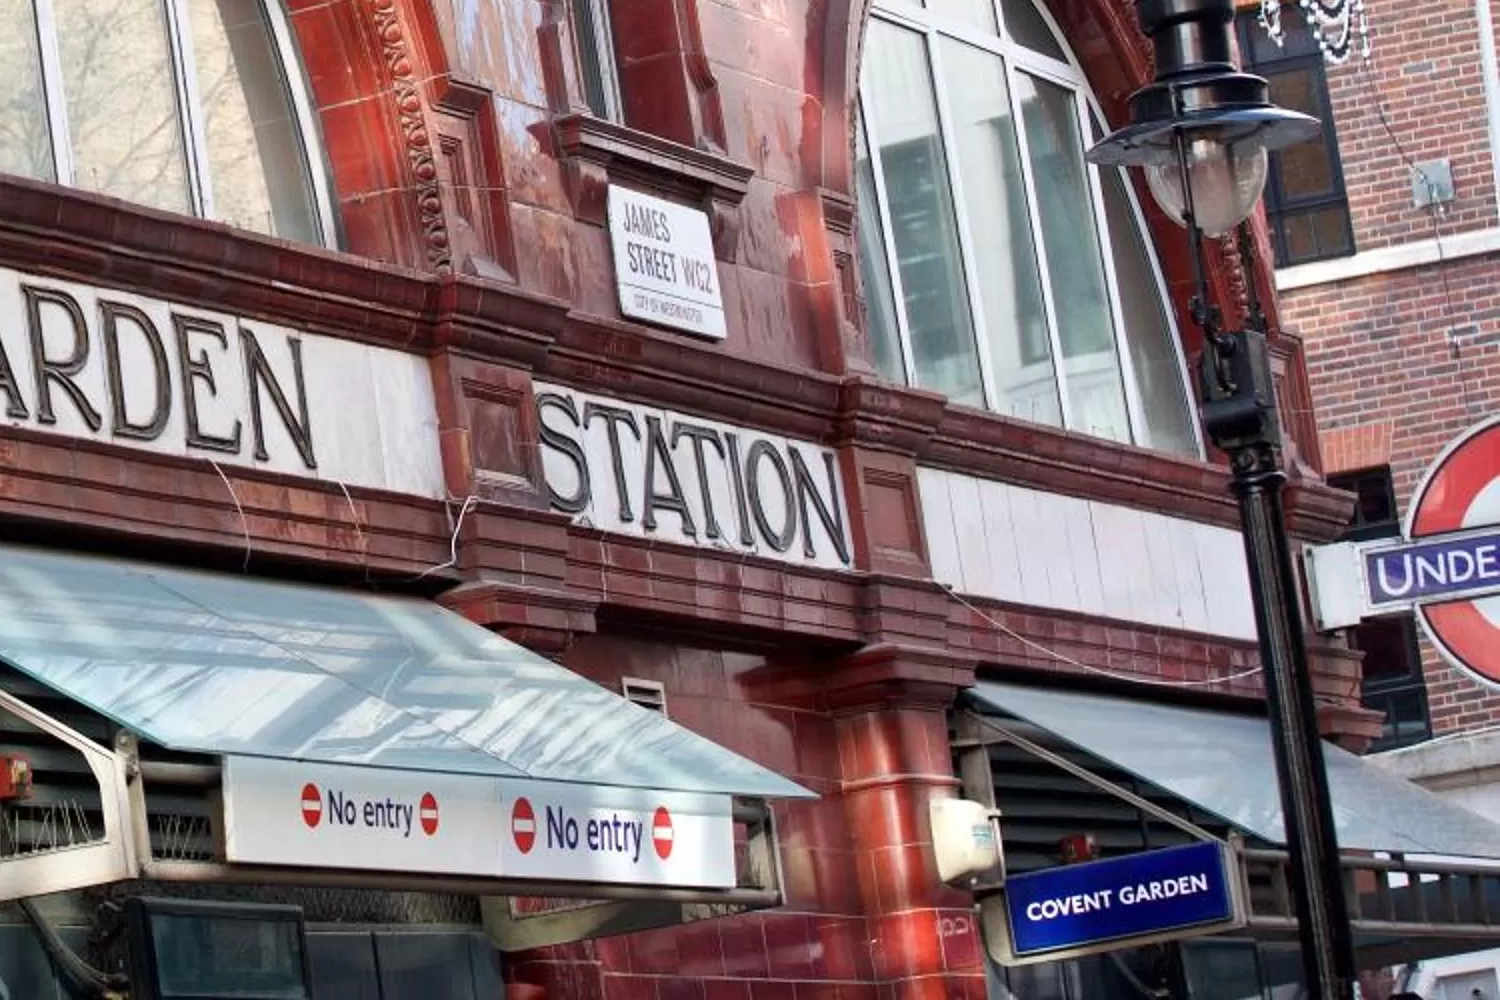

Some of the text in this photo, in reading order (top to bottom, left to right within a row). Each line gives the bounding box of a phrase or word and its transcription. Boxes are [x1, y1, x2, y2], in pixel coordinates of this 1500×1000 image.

[623, 202, 671, 243] JAMES
[627, 241, 713, 294] STREET WC2
[536, 392, 850, 565] STATION
[1376, 544, 1500, 596] UNDE
[327, 789, 413, 838] No entry
[545, 805, 643, 863] No entry
[1026, 873, 1208, 921] COVENT GARDEN
